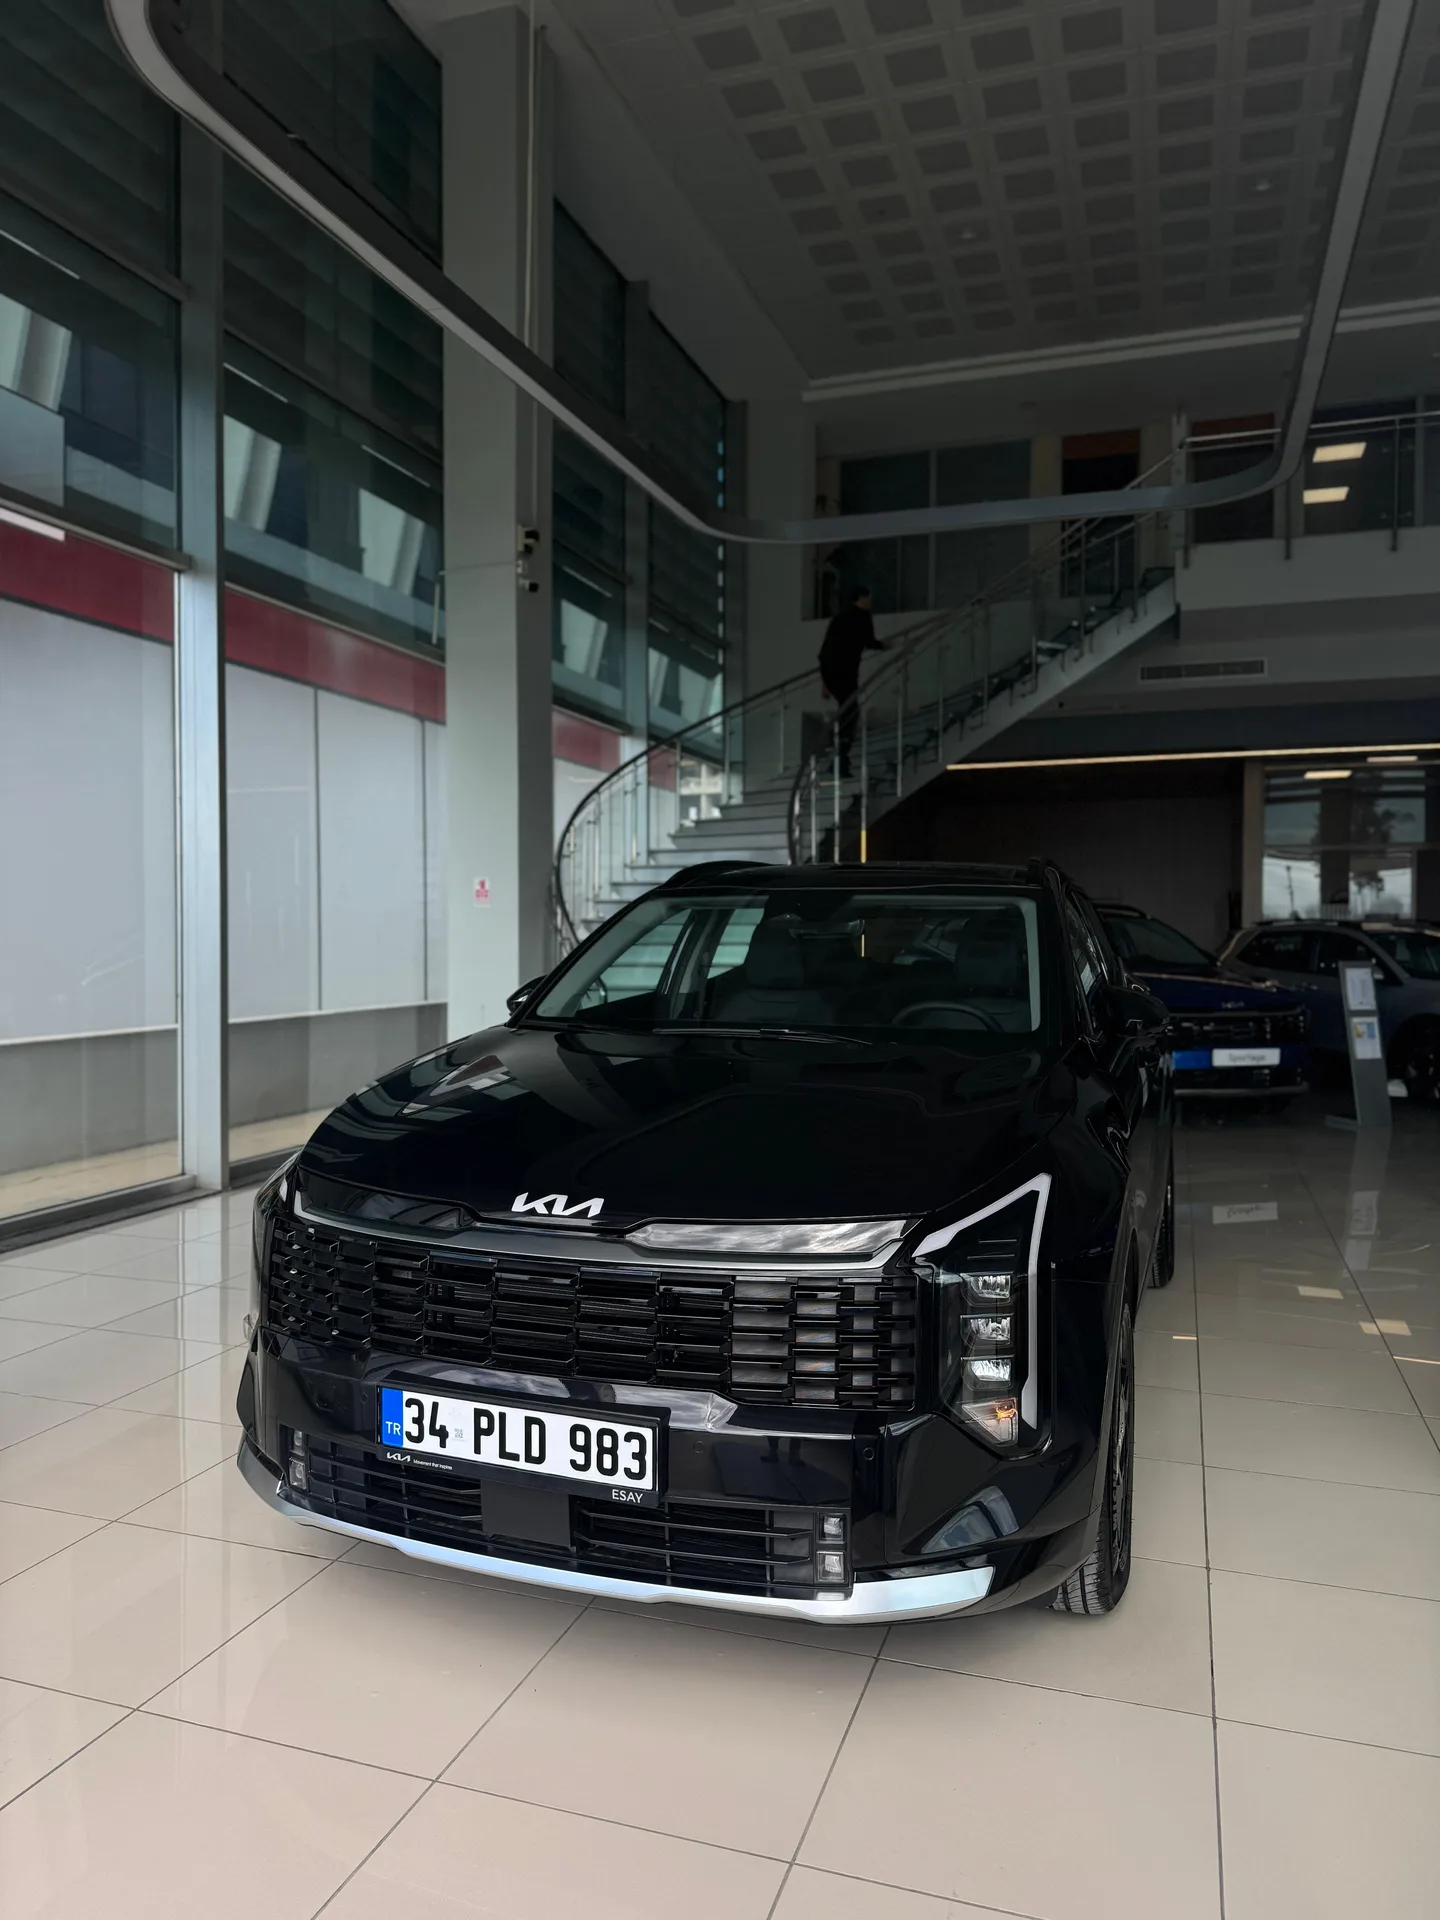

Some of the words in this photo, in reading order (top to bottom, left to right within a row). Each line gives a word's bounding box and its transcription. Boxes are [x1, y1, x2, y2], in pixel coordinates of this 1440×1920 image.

[511, 1192, 605, 1219] KIA
[385, 1420, 401, 1435] TR
[405, 1398, 449, 1449] 34
[473, 1407, 546, 1465] PLD
[569, 1423, 647, 1481] 983
[386, 1451, 411, 1462] KIA
[612, 1489, 643, 1504] ESAY
